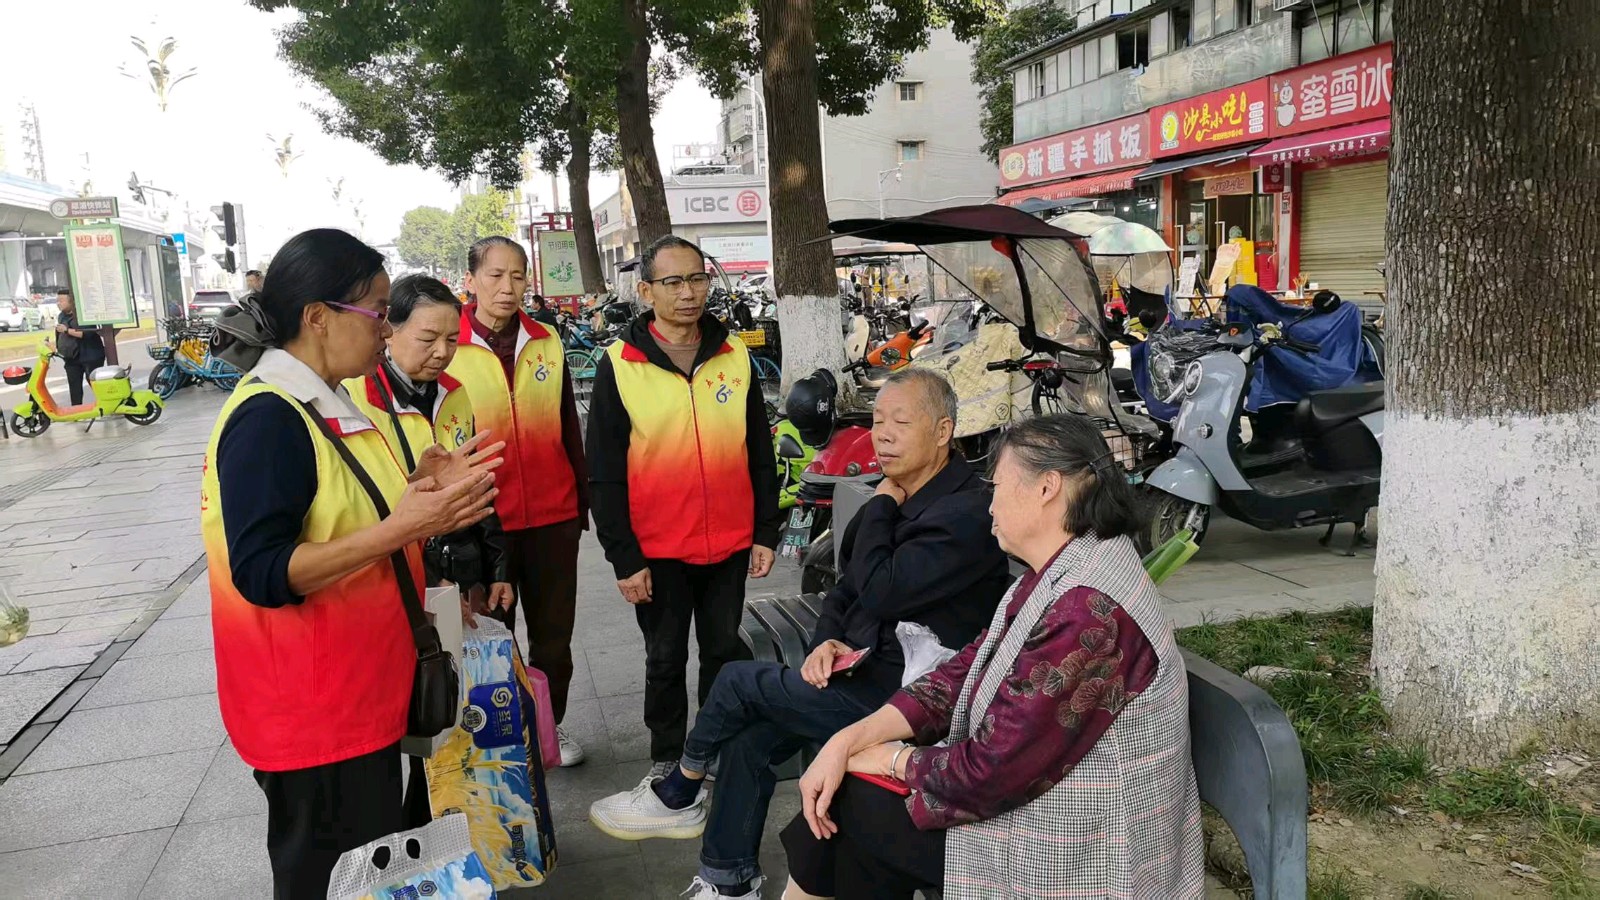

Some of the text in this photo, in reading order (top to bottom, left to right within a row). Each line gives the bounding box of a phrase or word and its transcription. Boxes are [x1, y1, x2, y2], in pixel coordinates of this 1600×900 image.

[1300, 57, 1392, 122] 蜜雪冰
[1183, 93, 1243, 142] 沙县小吃
[1027, 124, 1142, 177] 新疆手抓饭
[684, 196, 730, 213] ICBC
